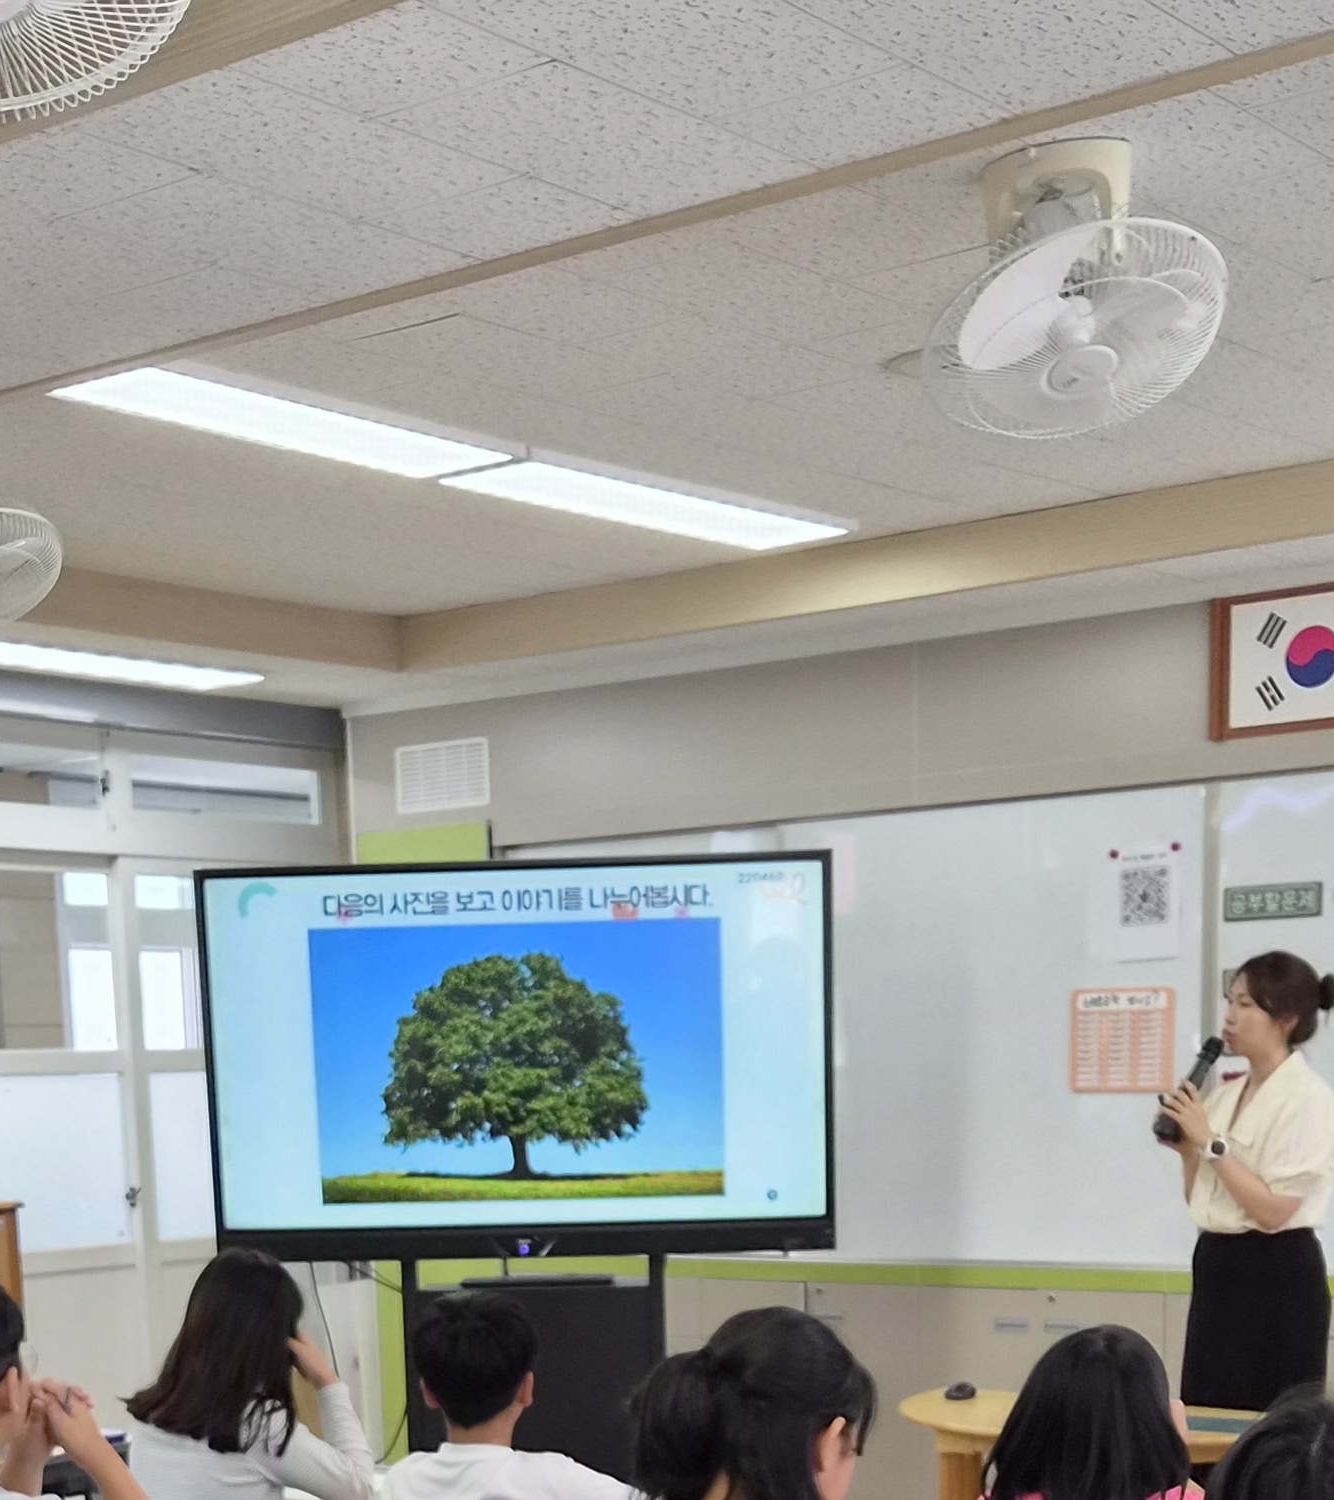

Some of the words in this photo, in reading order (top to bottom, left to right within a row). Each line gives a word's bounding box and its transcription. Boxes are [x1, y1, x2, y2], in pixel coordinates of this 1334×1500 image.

[322, 892, 385, 918] 다음의
[390, 890, 450, 916] 사진을
[455, 889, 498, 912] 보고
[502, 886, 583, 912] 이야기를
